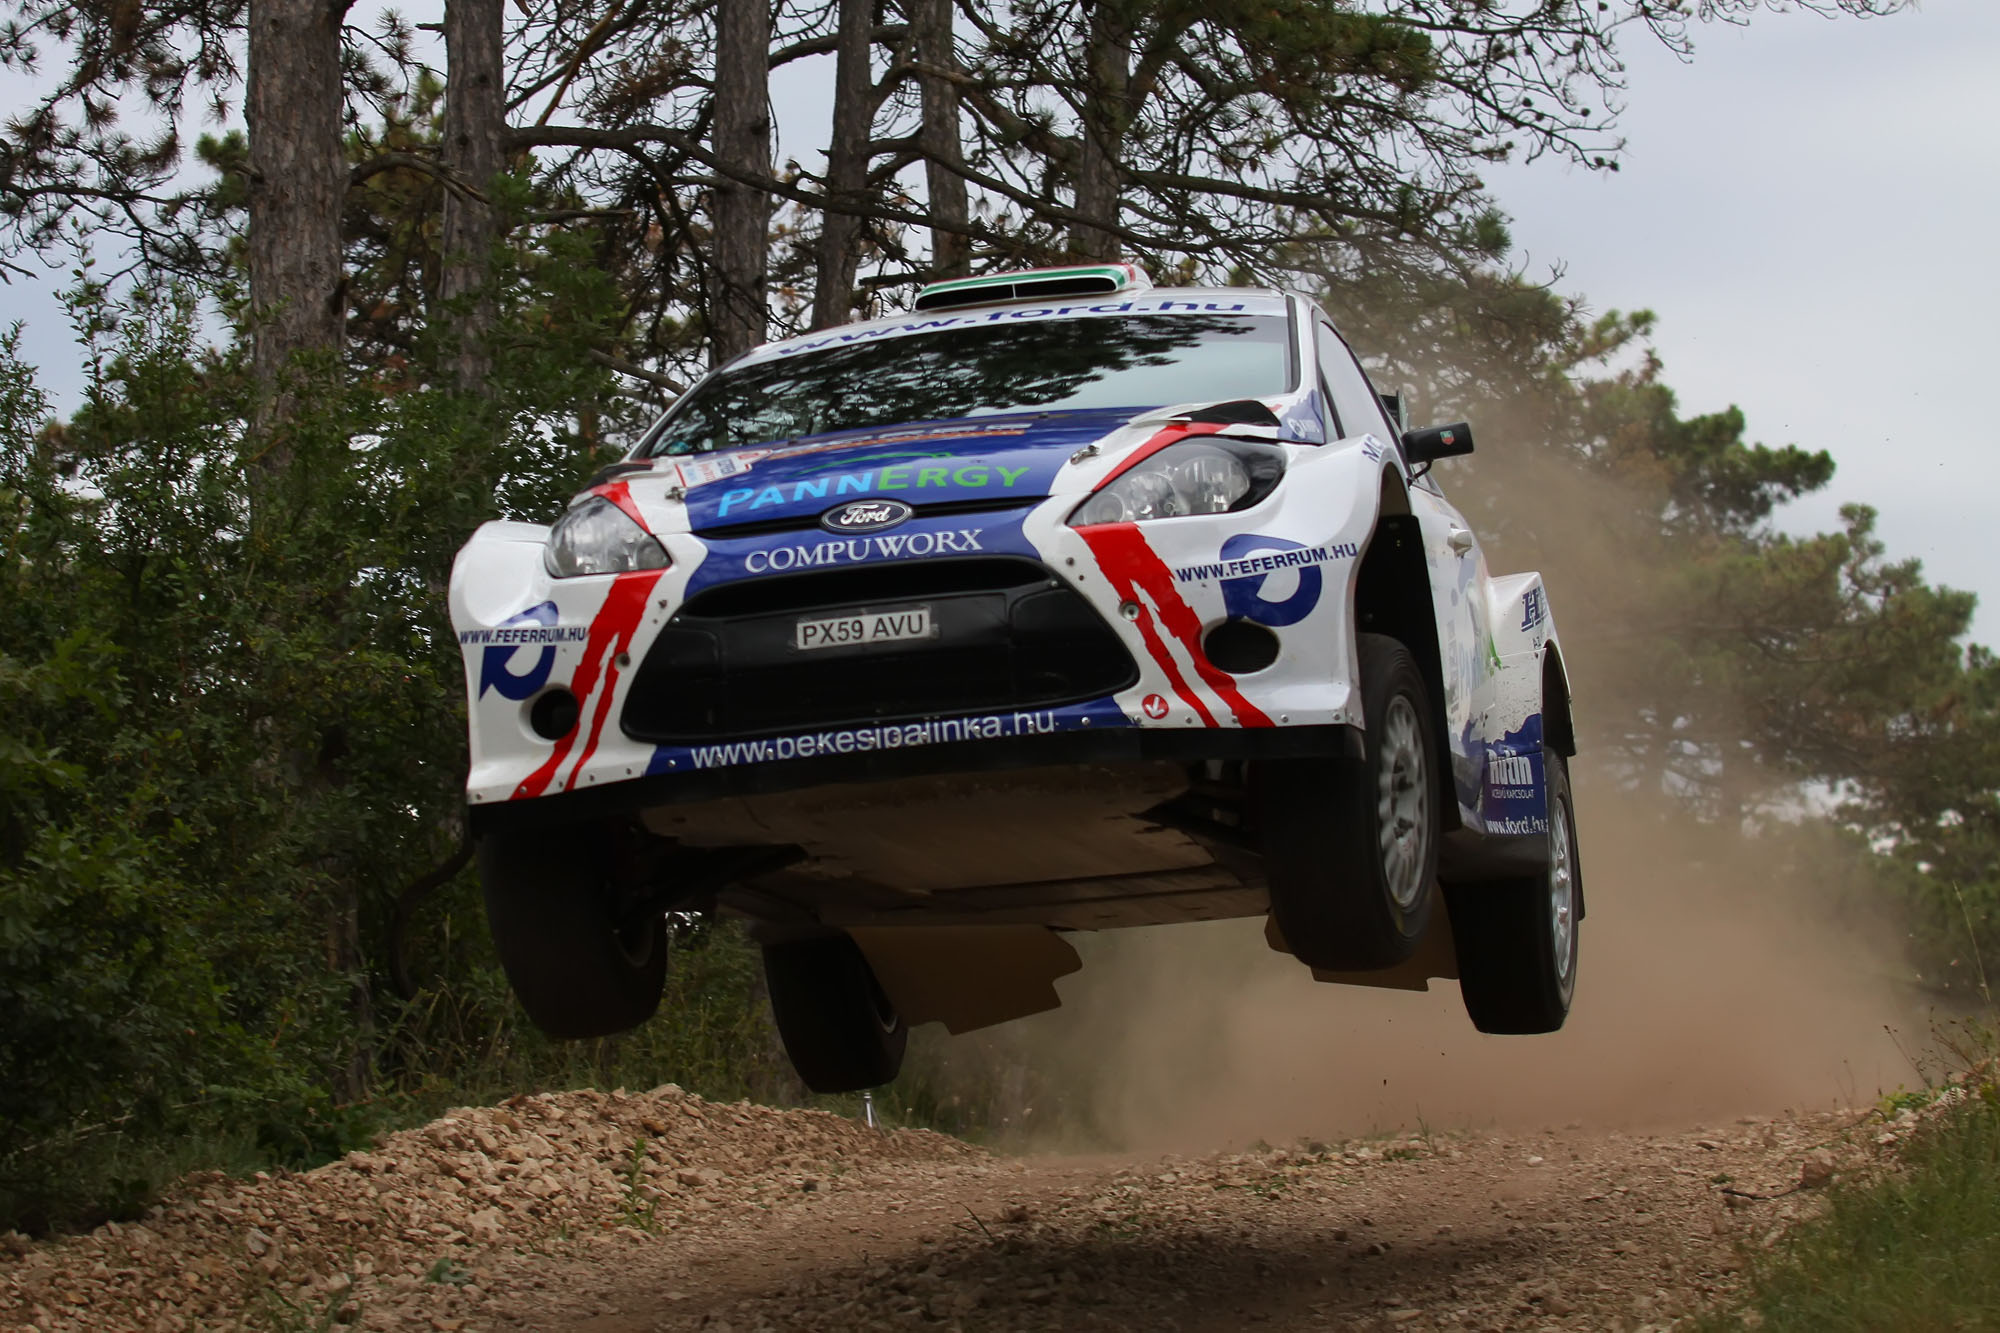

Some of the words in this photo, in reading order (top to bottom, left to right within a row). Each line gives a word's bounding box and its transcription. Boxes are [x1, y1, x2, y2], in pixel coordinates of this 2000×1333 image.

[778, 301, 1247, 356] www.ford.hu
[717, 466, 1031, 517] PANNERGY
[840, 504, 890, 526] Ford
[745, 528, 984, 574] COMPUWORX
[1176, 543, 1358, 582] WWW.FEFERRUM.HU
[460, 627, 586, 644] WWW.FEFERRUM.HU
[802, 619, 864, 646] PX59
[872, 613, 924, 639] AVU
[690, 711, 1055, 768] www.bekesipalinka.hu
